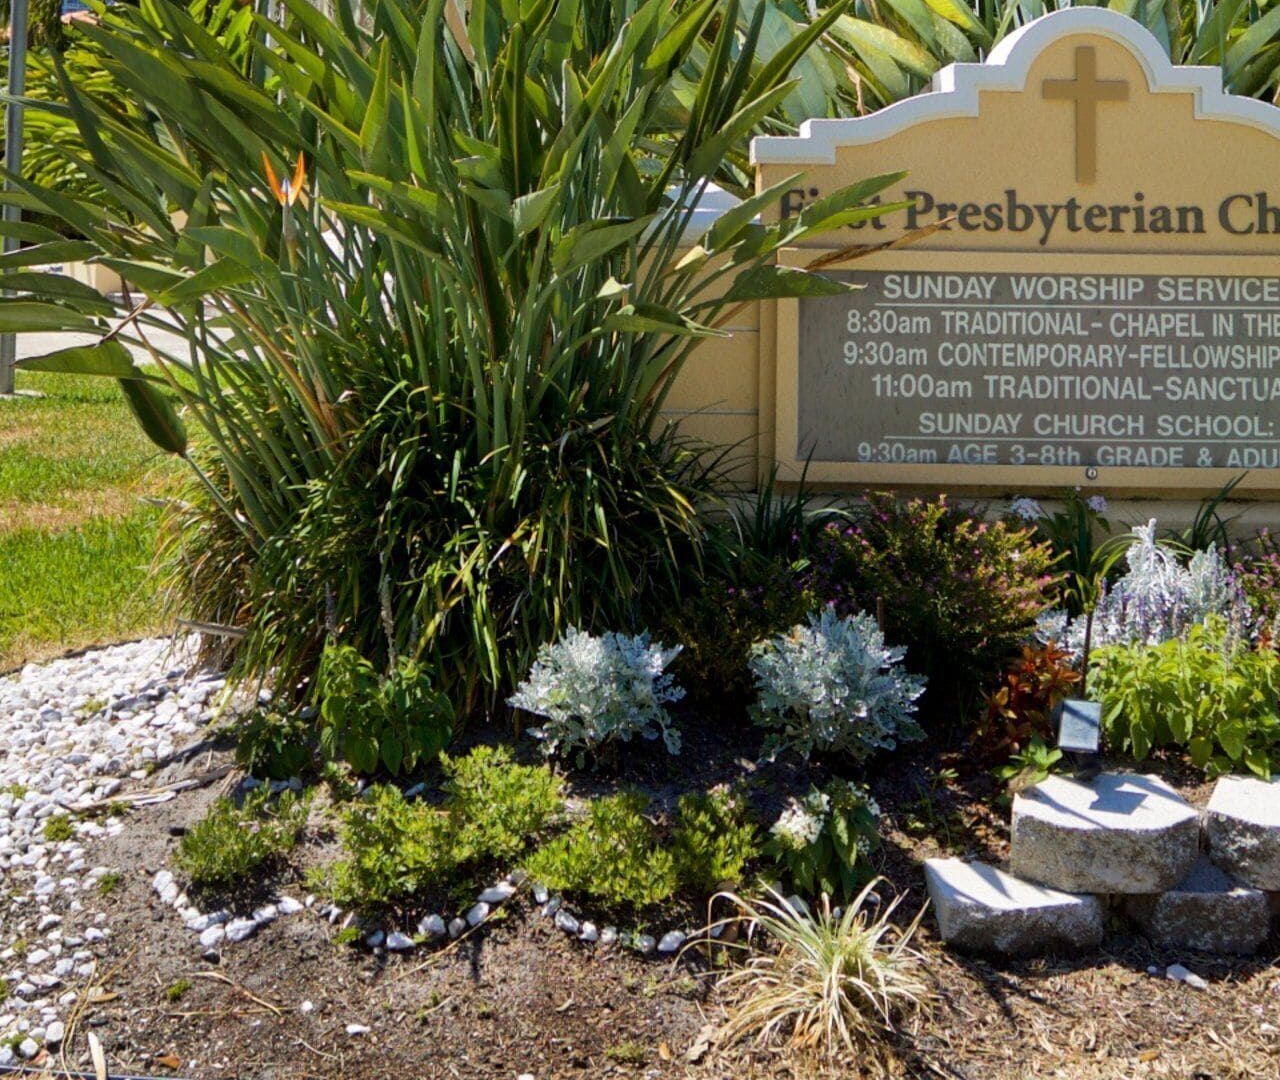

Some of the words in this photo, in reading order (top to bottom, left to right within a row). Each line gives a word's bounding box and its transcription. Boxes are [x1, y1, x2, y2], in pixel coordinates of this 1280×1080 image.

[903, 189, 1207, 246] Presbyterian
[882, 274, 997, 299] SUNDAY
[1010, 276, 1145, 301] WORSHIP
[846, 309, 932, 334] 8:30am
[1109, 312, 1205, 338] CHAPEL
[1212, 313, 1234, 337] IN
[842, 341, 928, 366] 9:30am
[871, 373, 972, 398] 11:00am
[919, 412, 1022, 434] SUNDAY
[1033, 414, 1145, 436] CHURCH
[1156, 415, 1275, 437] SCHOOL:
[857, 442, 937, 463] 9:30am
[947, 444, 998, 464] AGE
[1009, 445, 1081, 465] 3-8th
[1096, 446, 1184, 467] GRADE
[1196, 447, 1213, 466] &
